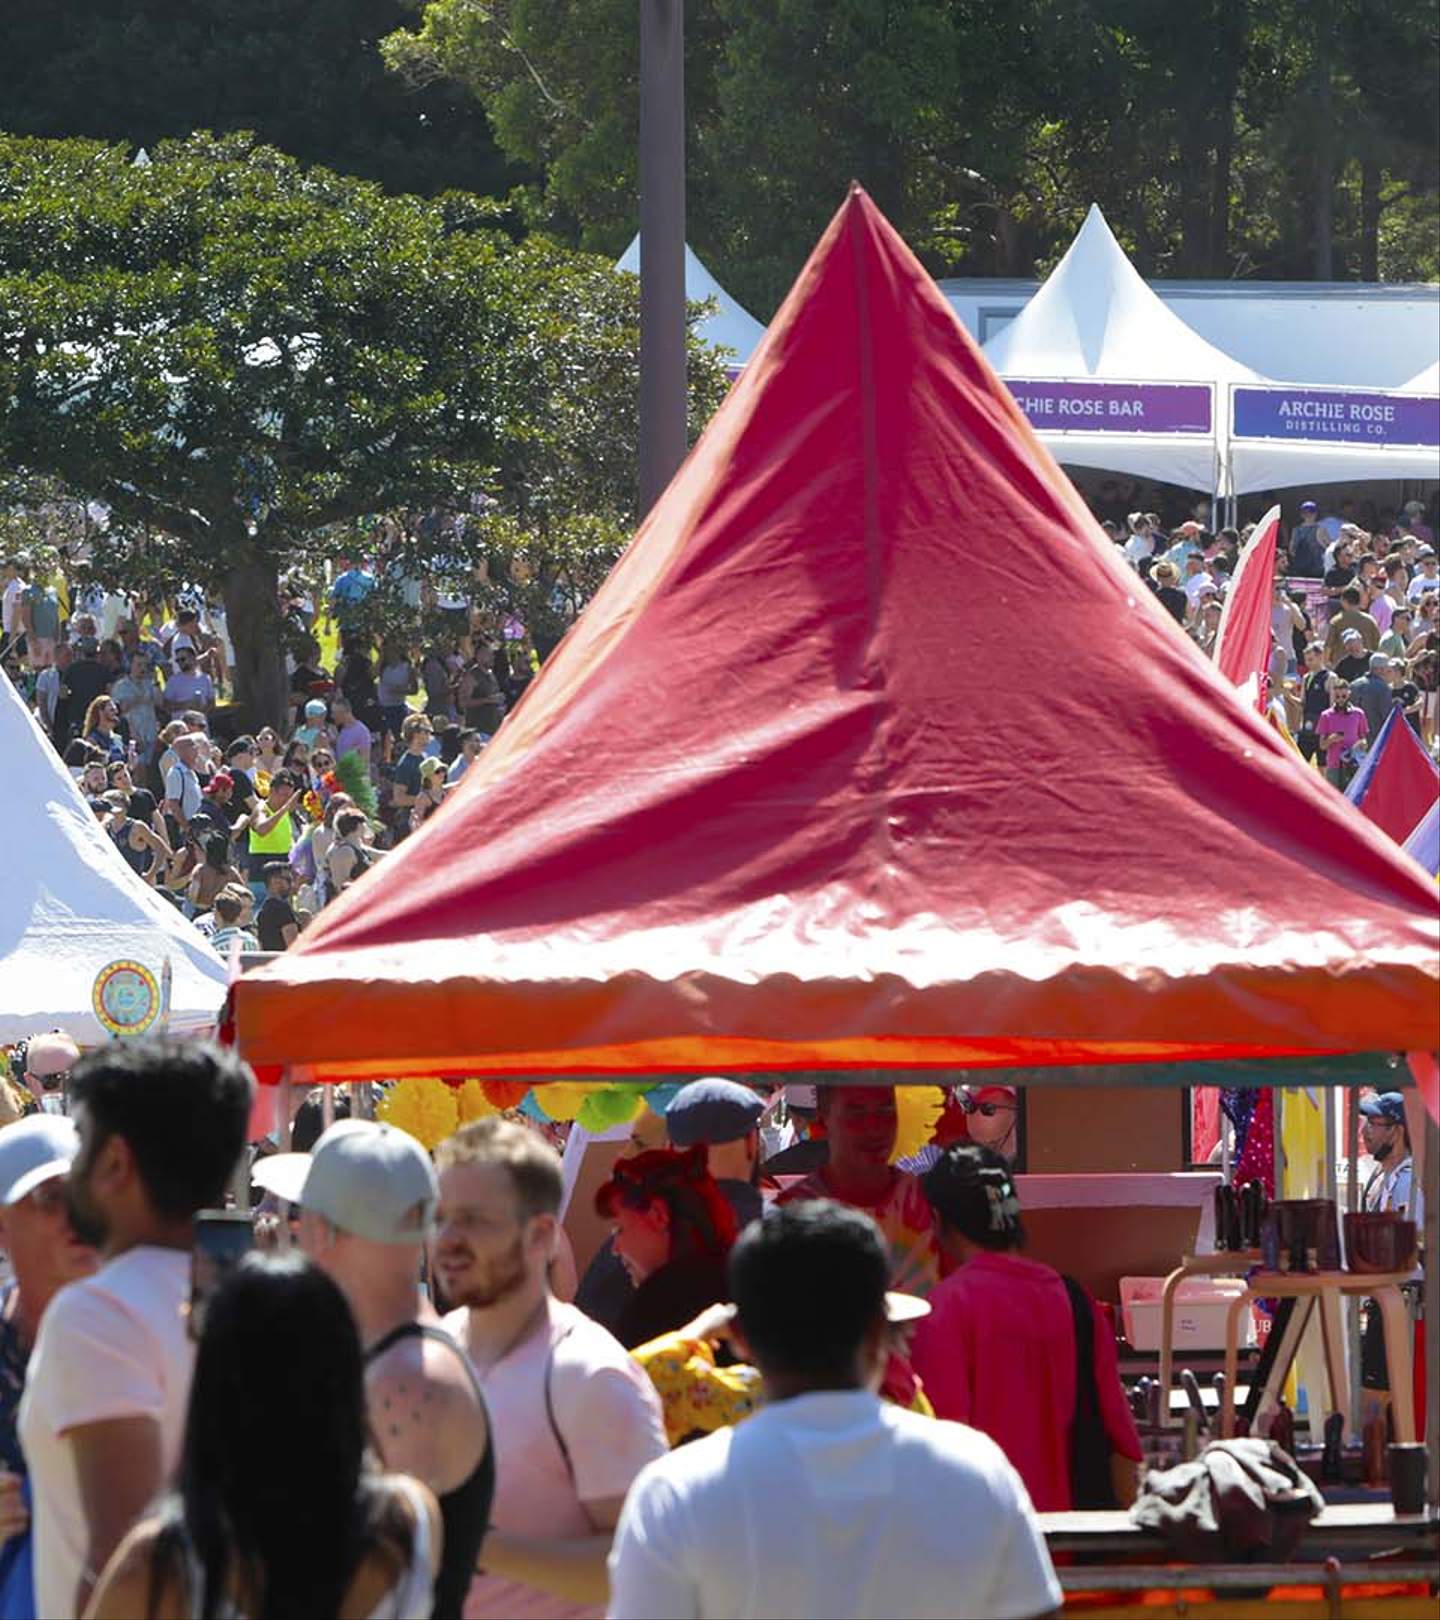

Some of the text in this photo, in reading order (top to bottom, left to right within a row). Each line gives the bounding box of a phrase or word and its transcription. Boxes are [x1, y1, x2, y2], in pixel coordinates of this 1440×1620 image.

[1058, 399, 1104, 415] ROSE
[1109, 400, 1144, 416] BAR
[1278, 401, 1395, 421] ARCHIE ROSE
[1286, 420, 1387, 435] DISTILLING CO.
